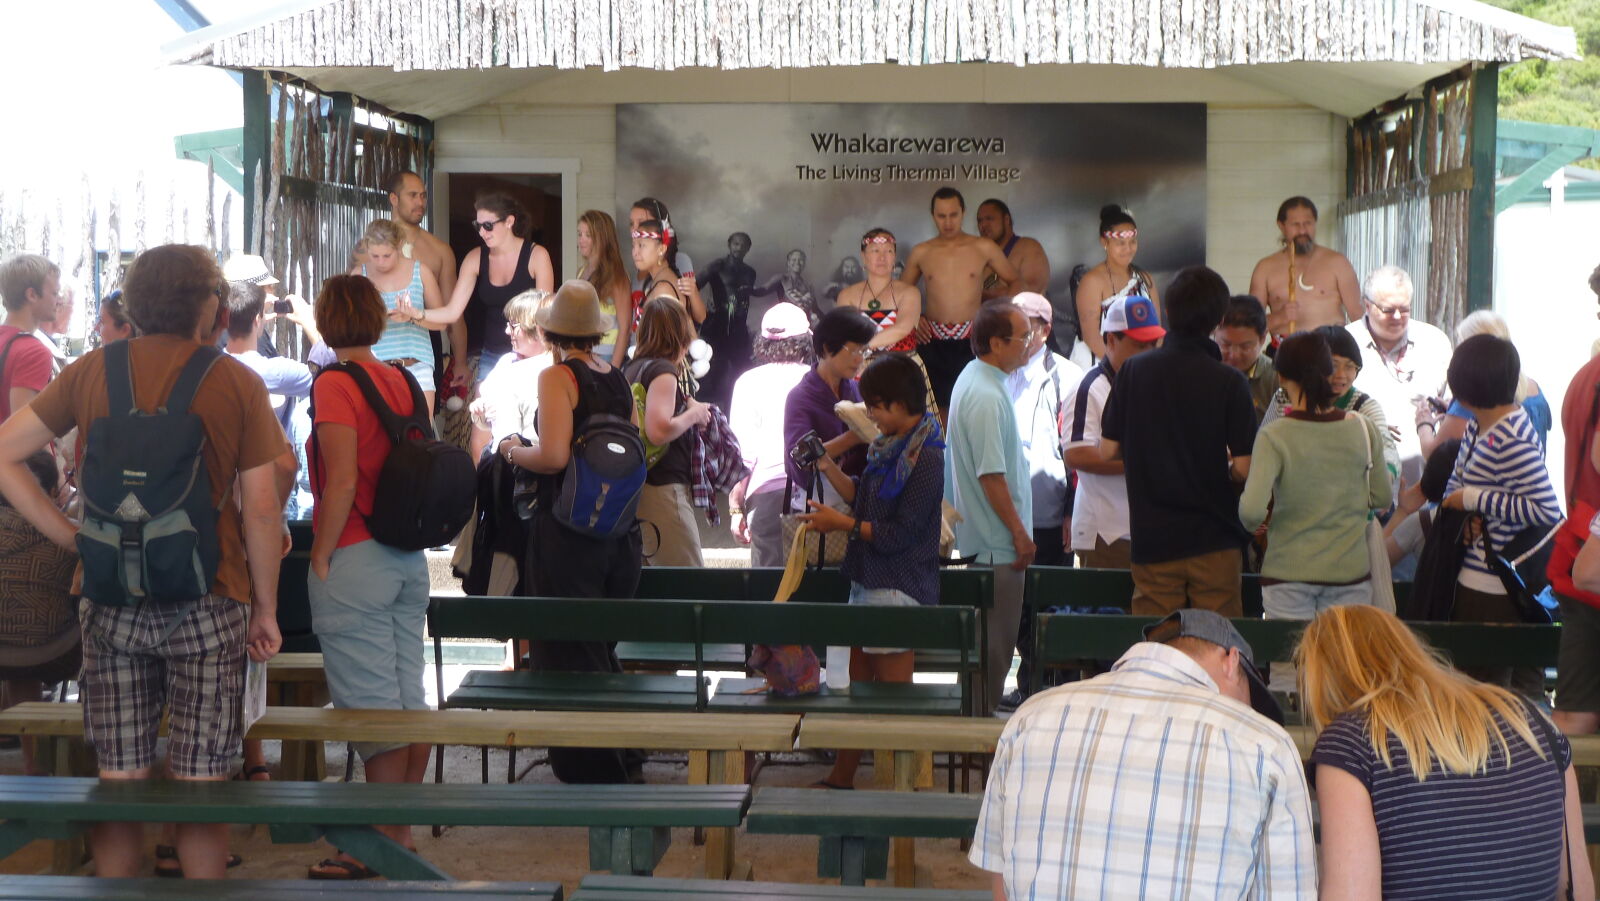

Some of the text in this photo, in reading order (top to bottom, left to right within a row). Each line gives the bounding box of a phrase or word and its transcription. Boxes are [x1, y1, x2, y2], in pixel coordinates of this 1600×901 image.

[810, 132, 1006, 155] Whakarewarewa
[796, 164, 1021, 184] The Living Thermal Village
